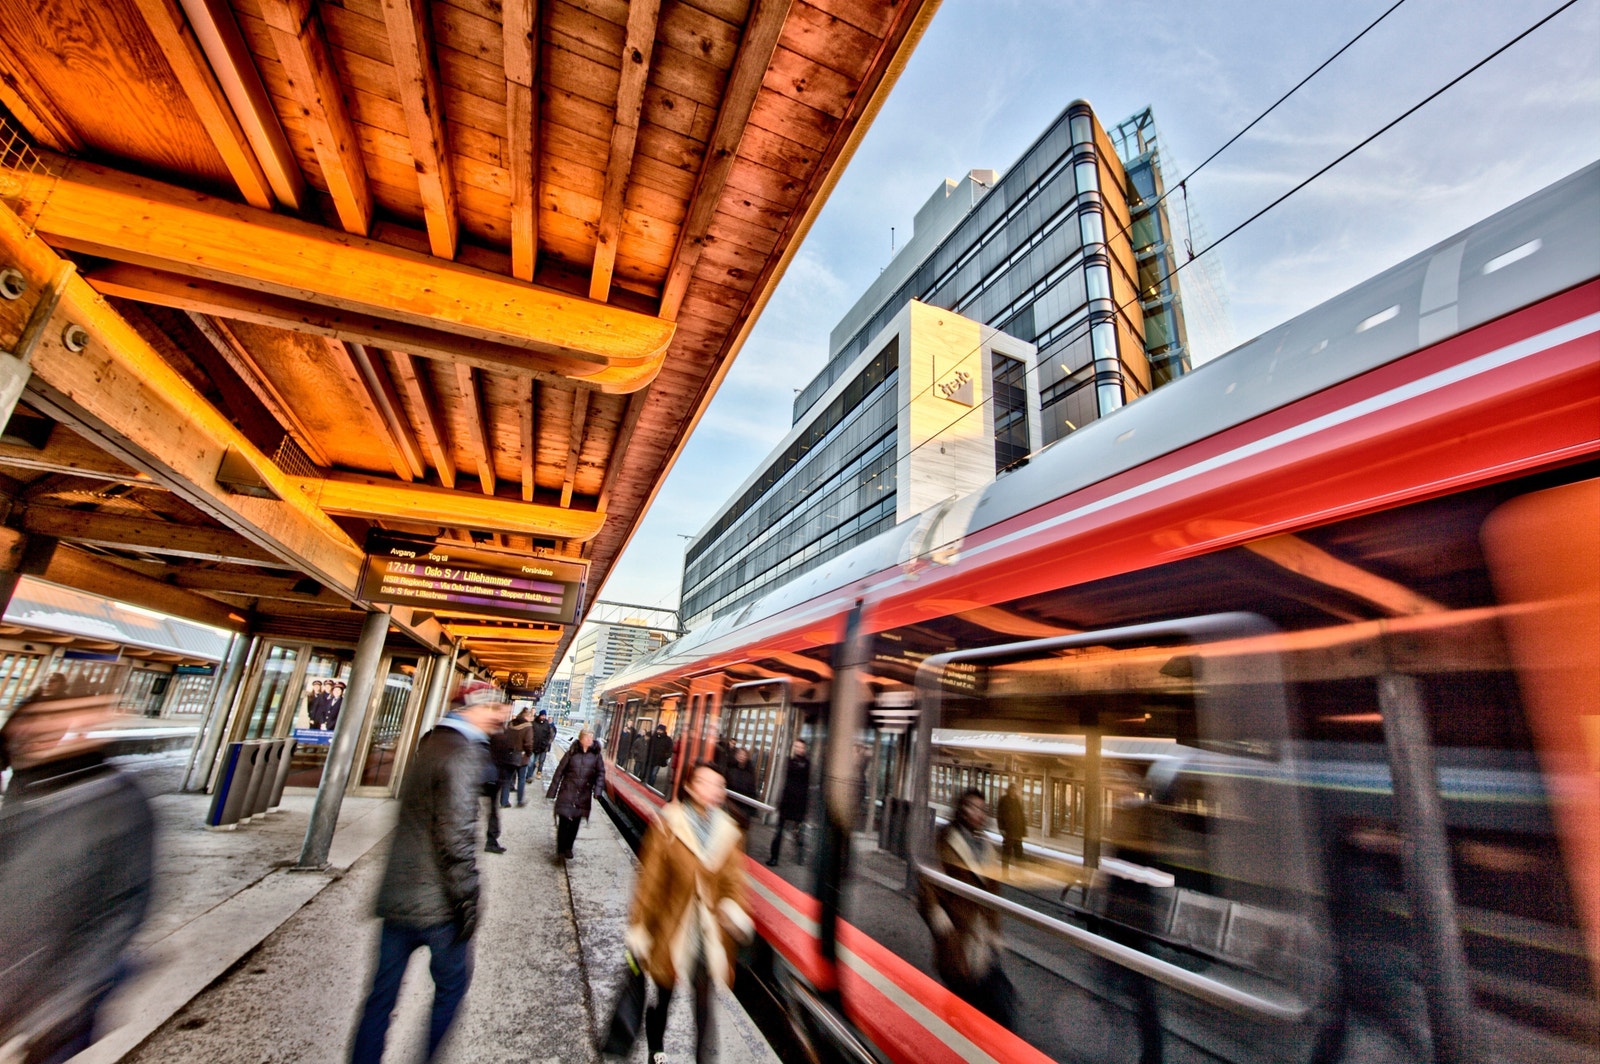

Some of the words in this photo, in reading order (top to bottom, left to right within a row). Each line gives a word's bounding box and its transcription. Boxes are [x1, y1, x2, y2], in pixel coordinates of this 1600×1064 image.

[390, 548, 416, 558] Avgang
[428, 553, 441, 562] Tog
[441, 554, 449, 562] til
[388, 560, 416, 574] 17:14
[424, 566, 443, 578] Oslo
[444, 568, 452, 579] S
[463, 570, 512, 586] Lillehammer
[522, 566, 554, 576] Forsinkelse
[380, 586, 395, 594] Oslo
[397, 587, 403, 595] S
[400, 576, 434, 588] Regiontog
[440, 581, 450, 590] Via
[451, 583, 465, 592] Oslo
[466, 585, 494, 595] Lufthavn
[500, 588, 524, 599] Stopper
[543, 595, 552, 603] og
